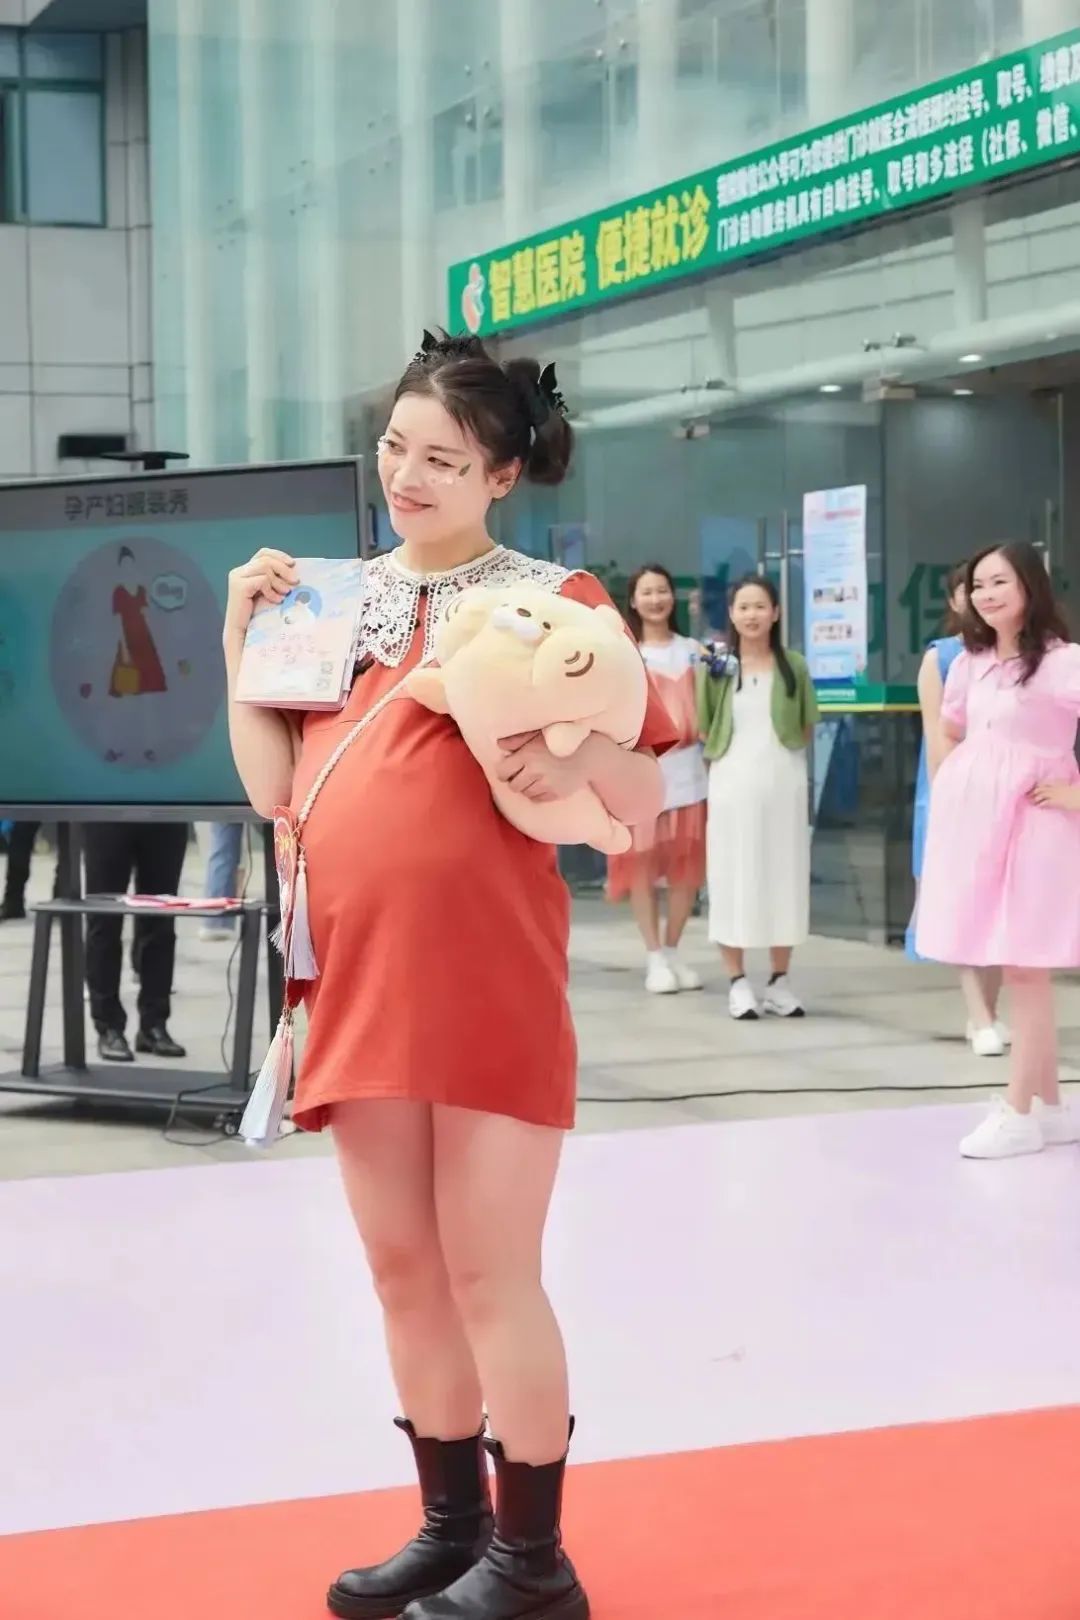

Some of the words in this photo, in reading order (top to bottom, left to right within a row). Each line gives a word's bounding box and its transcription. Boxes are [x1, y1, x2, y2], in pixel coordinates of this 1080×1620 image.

[489, 230, 586, 323] 智慧医院
[596, 184, 711, 290] 便捷就诊
[64, 488, 189, 521] 孕产妇服装秀
